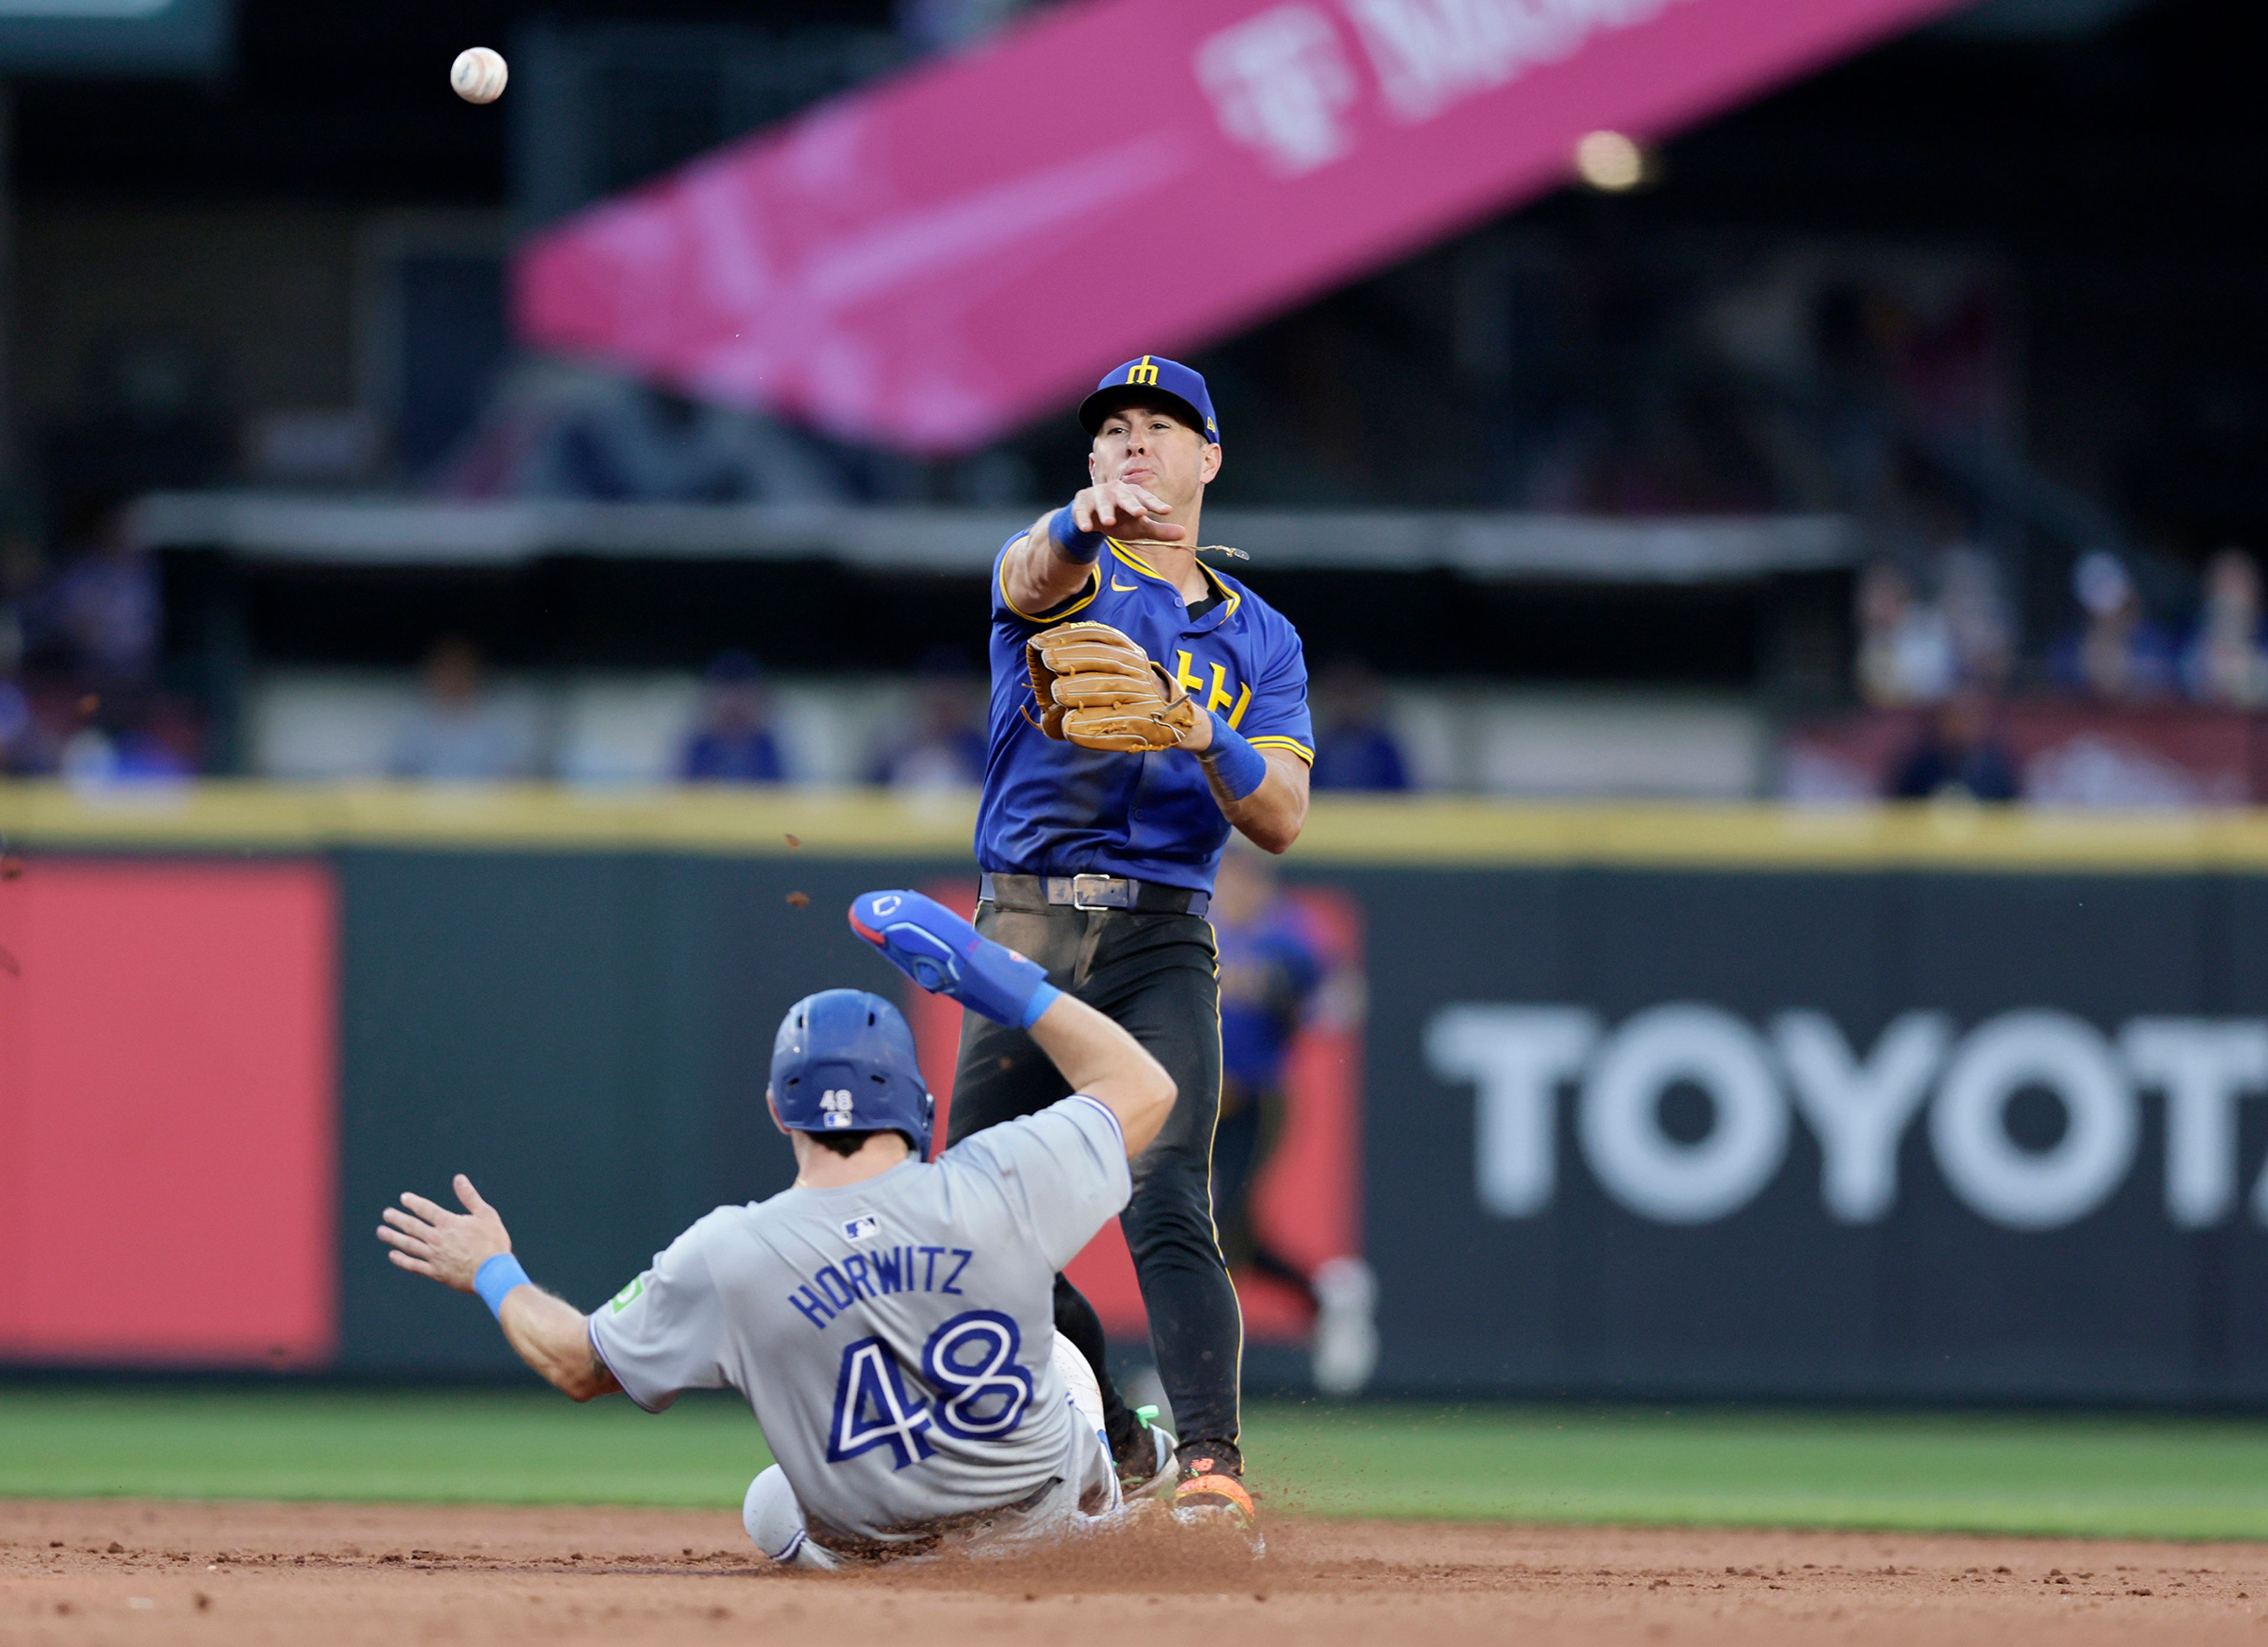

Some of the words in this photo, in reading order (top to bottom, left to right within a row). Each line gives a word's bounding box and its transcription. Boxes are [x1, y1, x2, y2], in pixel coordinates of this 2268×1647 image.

[819, 1089, 853, 1111] 48
[1423, 1002, 2268, 1232] TOYOT
[788, 1245, 973, 1330] HORWITZ
[827, 1309, 1034, 1472] 48
